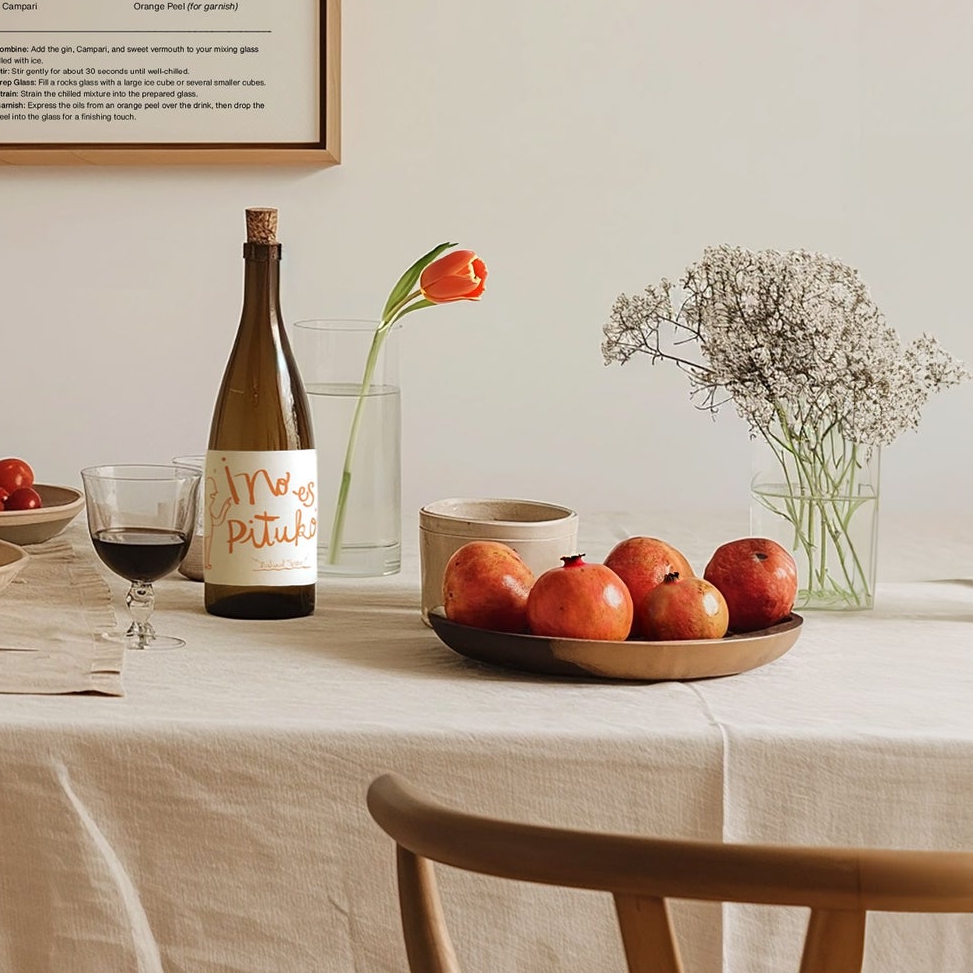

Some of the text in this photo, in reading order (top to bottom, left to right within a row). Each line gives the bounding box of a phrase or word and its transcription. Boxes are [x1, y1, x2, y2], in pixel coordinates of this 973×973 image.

[2, 2, 37, 12] Campari
[133, 2, 238, 12] Orange Peel (for garnish)
[31, 45, 45, 53] Add
[47, 45, 59, 53] the
[61, 45, 75, 54] gin,
[76, 45, 109, 54] Campari,
[112, 45, 125, 53] and
[127, 45, 148, 53] sweet
[150, 45, 184, 53] vermouth
[187, 45, 194, 53] to
[196, 45, 212, 54] your
[214, 45, 238, 54] mixing
[240, 45, 259, 54] glass
[26, 68, 49, 76] gently
[79, 79, 98, 87] glass
[124, 79, 142, 87] large
[142, 90, 175, 98] prepared
[177, 90, 198, 98] glass.
[28, 101, 57, 110] Express
[58, 101, 71, 109] the
[73, 101, 85, 109] oils
[87, 101, 104, 109] from
[106, 101, 114, 109] an
[117, 101, 142, 110] orange
[145, 101, 160, 110] peel
[162, 101, 178, 109] over
[179, 101, 191, 109] the
[193, 101, 213, 110] drink,
[216, 101, 232, 109] then
[234, 101, 251, 110] drop
[253, 101, 265, 109] the
[41, 113, 60, 121] glass
[82, 113, 111, 121] finishing
[292, 481, 315, 507] es
